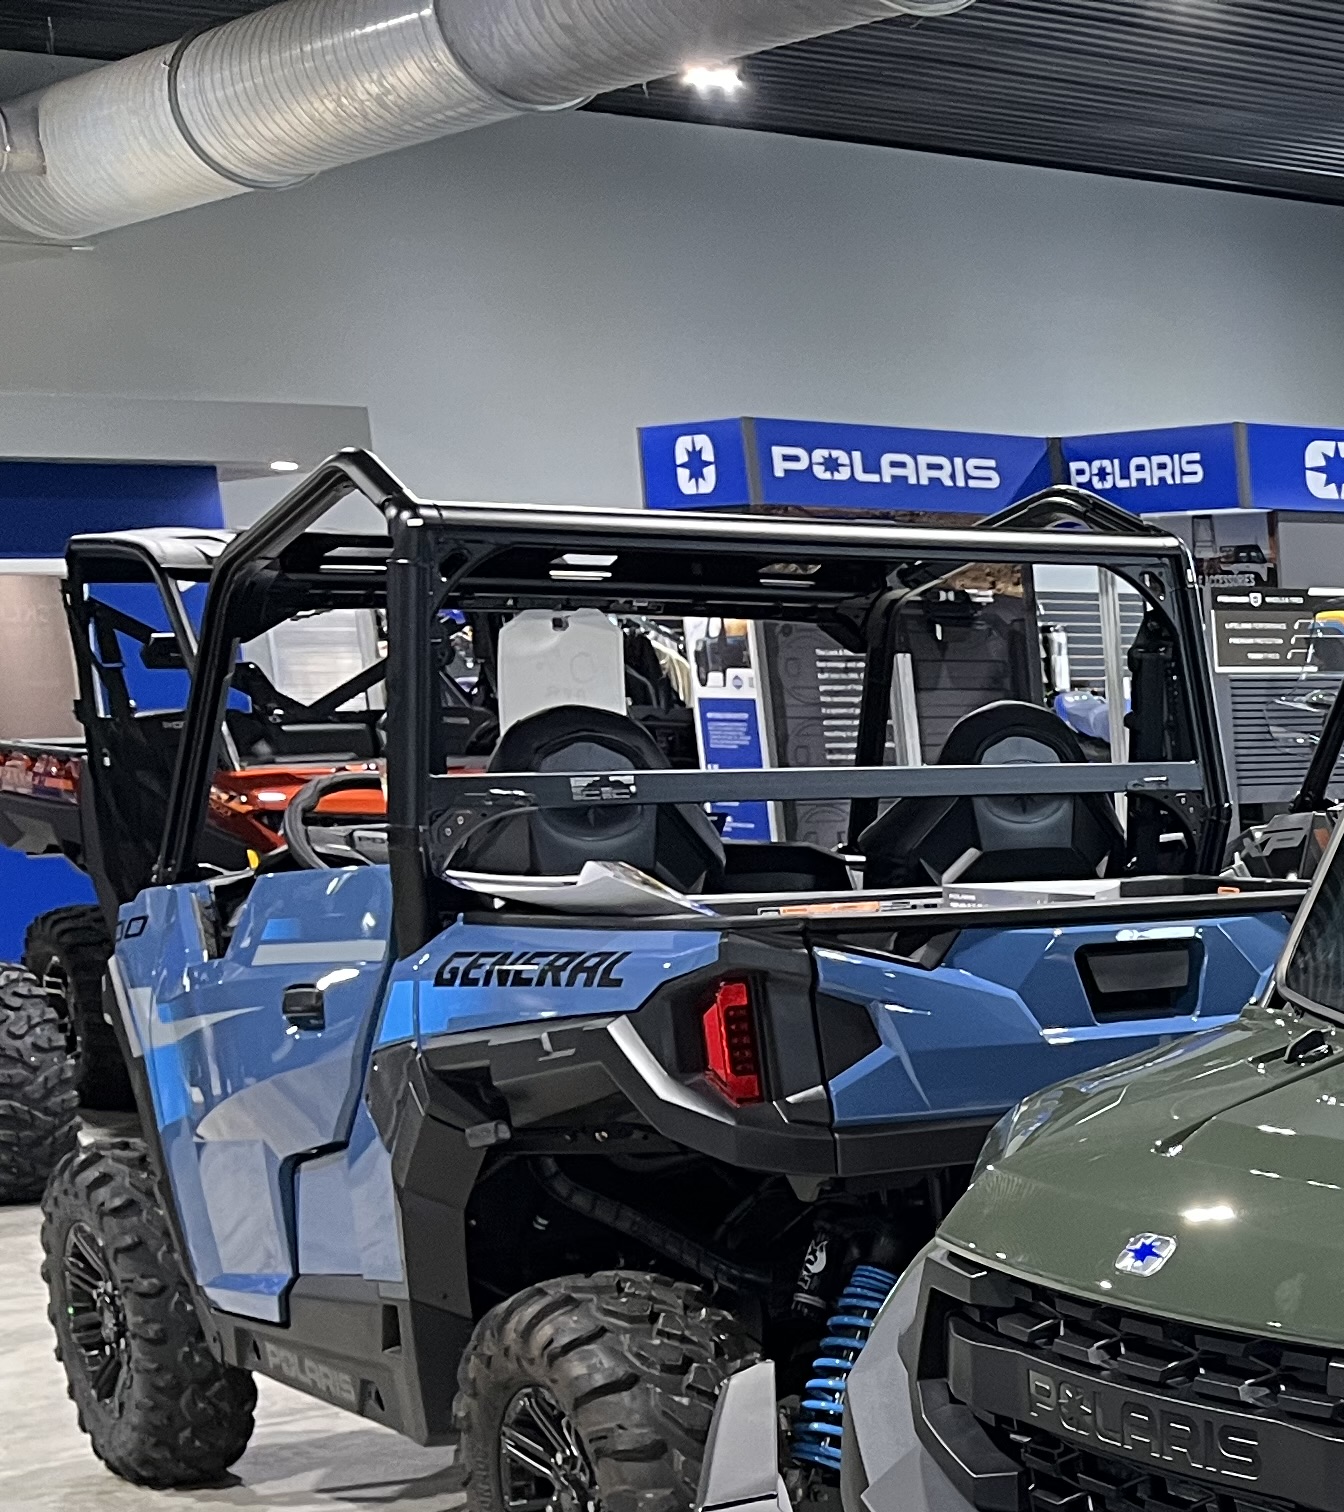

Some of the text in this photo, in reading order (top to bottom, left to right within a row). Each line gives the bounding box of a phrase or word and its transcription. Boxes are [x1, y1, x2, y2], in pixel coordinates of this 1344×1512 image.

[771, 446, 1000, 489] POLARIS
[1069, 452, 1202, 489] POLARIS
[433, 951, 632, 987] GENERAL
[264, 1340, 357, 1402] POLARIS
[1027, 1368, 1263, 1483] POLARIS
